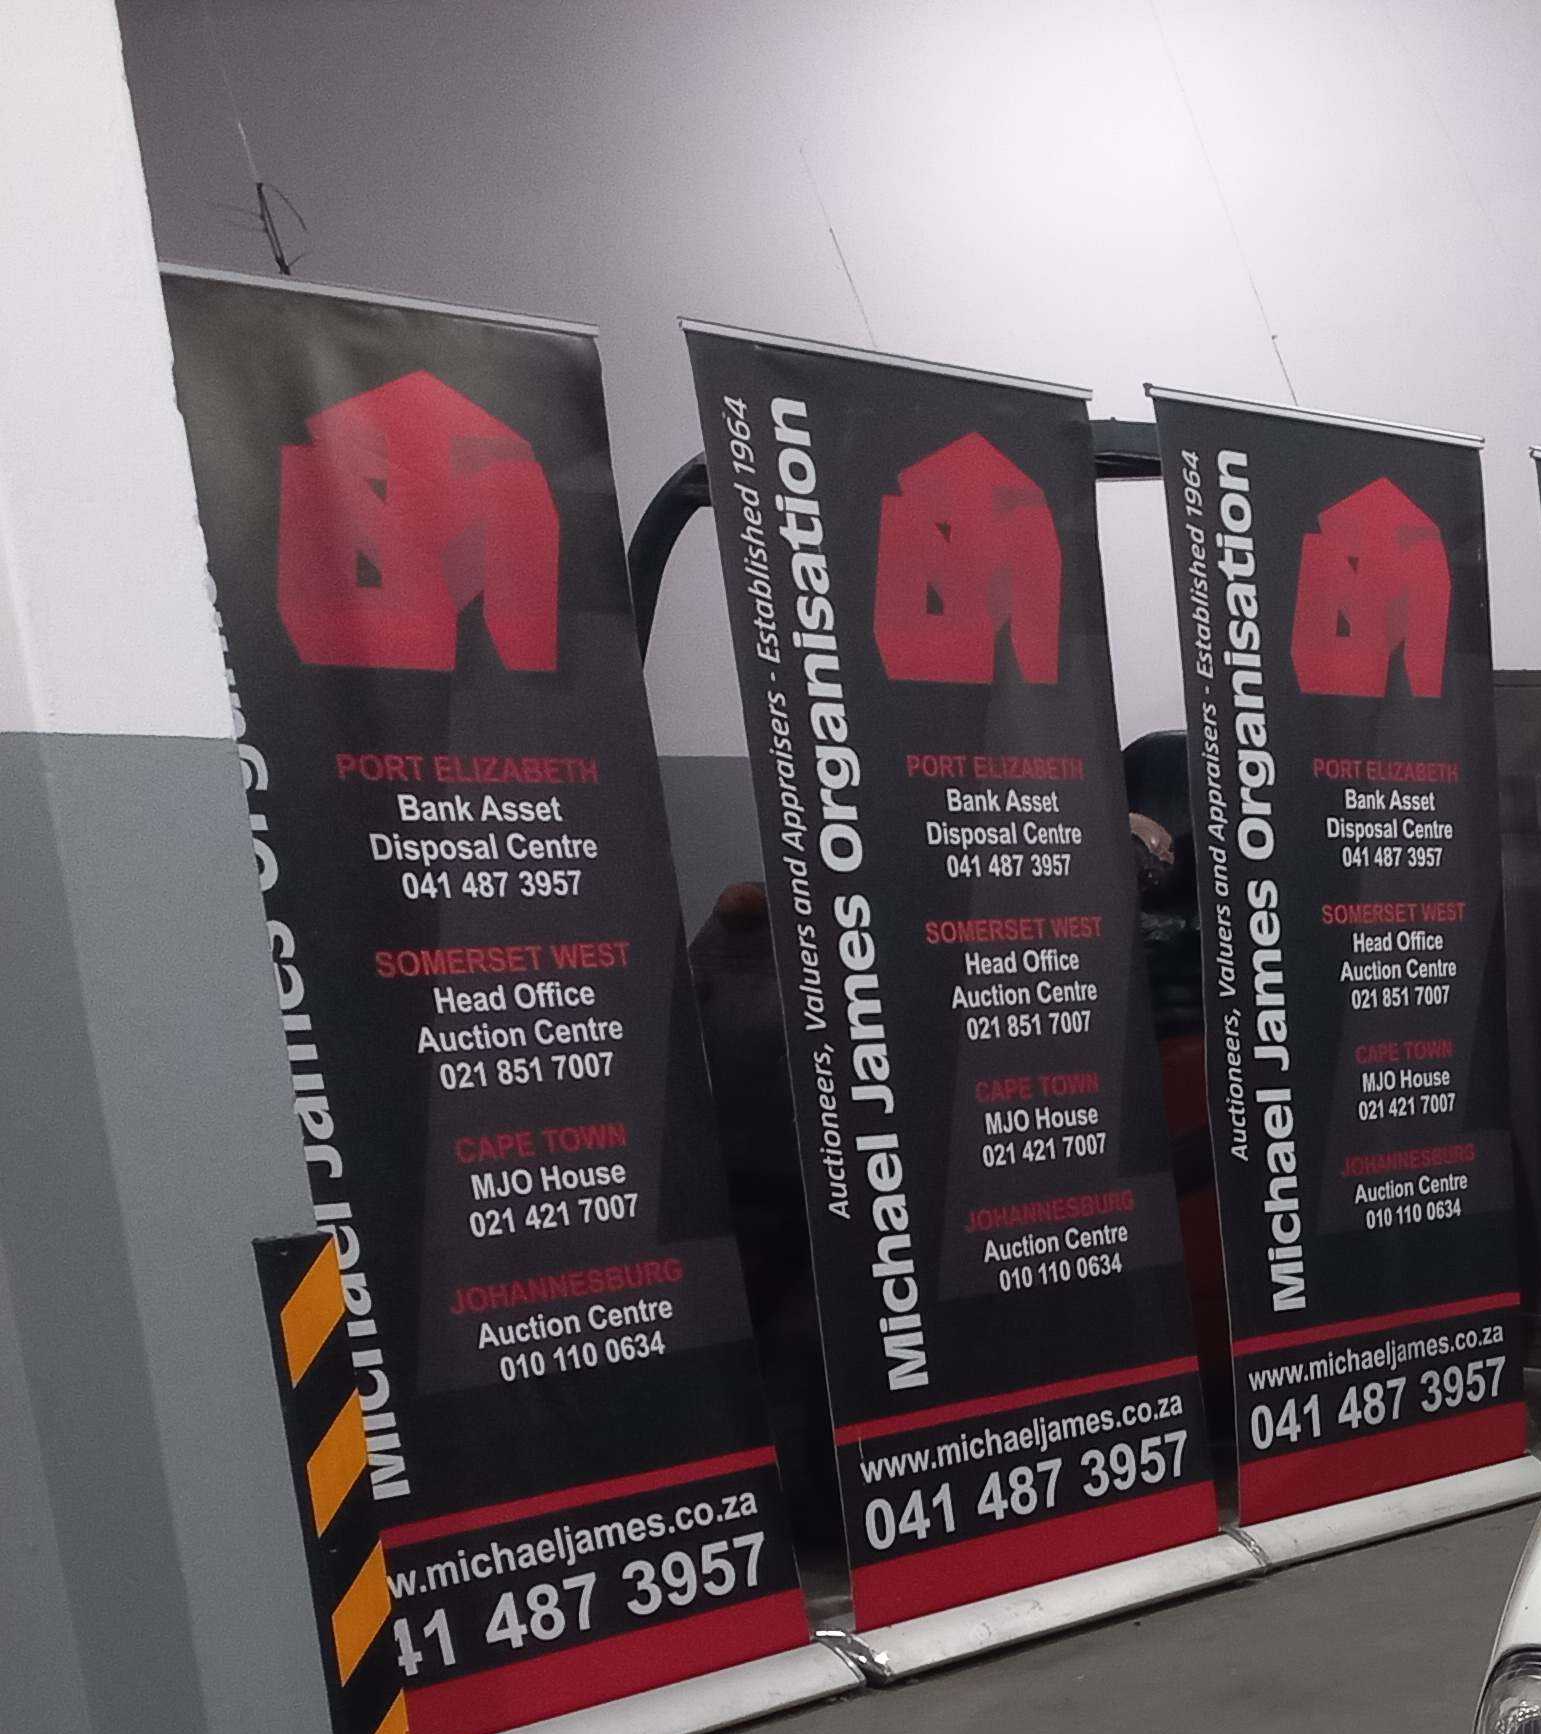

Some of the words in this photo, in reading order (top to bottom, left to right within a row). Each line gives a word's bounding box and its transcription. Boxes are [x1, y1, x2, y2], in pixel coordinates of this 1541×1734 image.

[722, 395, 756, 474] 1964
[1181, 449, 1203, 516] 1964
[734, 482, 779, 664] Established
[1185, 523, 1214, 679] Established
[771, 397, 863, 872] Organisation
[1217, 449, 1276, 861] Organisation
[336, 753, 423, 780] PORT
[433, 754, 597, 784] ELIZABETH
[767, 691, 807, 851] Appraisers
[906, 754, 965, 776] PORT
[972, 756, 1082, 779] ELIZABETH
[1201, 701, 1229, 842] Appraisers
[1313, 759, 1361, 778] PORT
[1368, 760, 1458, 781] ELIZABETH
[397, 794, 474, 822] Bank
[480, 795, 563, 822] Asset
[946, 788, 1001, 812] Bank
[1005, 789, 1060, 813] Asset
[1345, 788, 1386, 810] Bank
[1389, 789, 1436, 811] Asset
[369, 832, 499, 867] Disposal
[506, 832, 598, 860] Centre
[926, 821, 1018, 851] Disposal
[1022, 821, 1082, 845] Centre
[1326, 817, 1398, 843] Disposal
[1402, 818, 1453, 840] Centre
[946, 854, 982, 878] 041
[988, 854, 1024, 877] 487
[1030, 853, 1071, 877] 3957
[1208, 845, 1229, 897] and
[1342, 846, 1370, 868] 041
[1373, 846, 1403, 868] 487
[1407, 846, 1443, 867] 3957
[402, 871, 452, 900] 041
[461, 871, 509, 898] 487
[518, 869, 582, 897] 3957
[783, 857, 812, 915] and
[927, 917, 1045, 943] SOMERSET
[1052, 916, 1099, 937] WEST
[1322, 903, 1416, 923] SOMERSET
[1422, 902, 1465, 921] WEST
[376, 944, 542, 978] SOMERSET
[552, 942, 629, 969] WEST
[1216, 904, 1236, 997] Valuers
[1352, 931, 1393, 953] Head
[1396, 930, 1444, 951] Office
[797, 924, 827, 1031] Valuers
[965, 950, 1018, 976] Head
[1022, 948, 1080, 973] Office
[1247, 879, 1290, 1071] James
[1340, 960, 1402, 982] Auction
[1405, 958, 1457, 979] Centre
[433, 984, 507, 1014] Head
[514, 981, 595, 1009] Office
[834, 894, 895, 1114] James
[952, 983, 1031, 1009] Auction
[1036, 980, 1098, 1004] Centre
[1351, 988, 1378, 1010] 021
[1382, 986, 1409, 1008] 851
[1414, 984, 1450, 1006] 7007
[418, 1022, 527, 1054] Auction
[534, 1017, 623, 1045] Centre
[966, 1015, 1001, 1041] 021
[1007, 1013, 1042, 1038] 851
[1048, 1010, 1091, 1035] 7007
[439, 1061, 488, 1090] 021
[496, 1056, 543, 1085] 851
[550, 1051, 614, 1080] 7007
[976, 1078, 1031, 1100] CAPE
[1040, 1072, 1099, 1094] TOWN
[1224, 1008, 1249, 1162] Auctioneers,
[1362, 1070, 1396, 1093] MJO
[1400, 1069, 1450, 1089] House
[985, 1109, 1030, 1135] MJO
[1034, 1106, 1099, 1130] House
[1358, 1099, 1384, 1121] 021
[1388, 1096, 1415, 1117] 421
[1420, 1092, 1456, 1114] 7007
[456, 1130, 536, 1164] CAPE
[543, 1124, 628, 1153] TOWN
[813, 1043, 851, 1220] Auctioneers,
[982, 1142, 1016, 1168] 021
[1022, 1137, 1056, 1162] 421
[1062, 1132, 1106, 1158] 7007
[470, 1169, 533, 1201] MJO
[539, 1164, 626, 1192] House
[1255, 1088, 1306, 1312] Michael
[1354, 1179, 1415, 1204] Auction
[1418, 1173, 1468, 1195] Centre
[469, 1207, 516, 1238] 021
[525, 1201, 570, 1230] 421
[577, 1192, 638, 1223] 7007
[965, 1190, 1134, 1232] JOHANNESBURG
[1366, 1207, 1393, 1230] 010
[1395, 1203, 1422, 1225] 110
[1426, 1197, 1462, 1221] 0634
[855, 1133, 929, 1391] Michael
[984, 1233, 1060, 1263] Auction
[1064, 1224, 1128, 1250] Centre
[452, 1259, 682, 1314] JOHANNESBURG
[999, 1265, 1033, 1292] 010
[1038, 1259, 1071, 1285] 110
[1076, 1252, 1123, 1279] 0634
[478, 1313, 582, 1349] Auction
[588, 1299, 673, 1330] Centre
[500, 1351, 545, 1382] 010
[553, 1342, 598, 1372] 110
[605, 1330, 666, 1363] 0634
[1249, 1324, 1503, 1391] www.michaeljames.co.za
[1251, 1393, 1321, 1450] 041
[1338, 1376, 1407, 1429] 487
[1420, 1355, 1506, 1413] 3957
[860, 1394, 1183, 1483] www.michaeljames.co.za
[865, 1482, 956, 1550] 041
[977, 1457, 1063, 1521] 487
[1080, 1429, 1188, 1497] 3957
[387, 1492, 758, 1599] w.michaeljames.co.za
[393, 1607, 456, 1676] 41
[485, 1571, 597, 1649] 487
[622, 1531, 765, 1615] 3957
